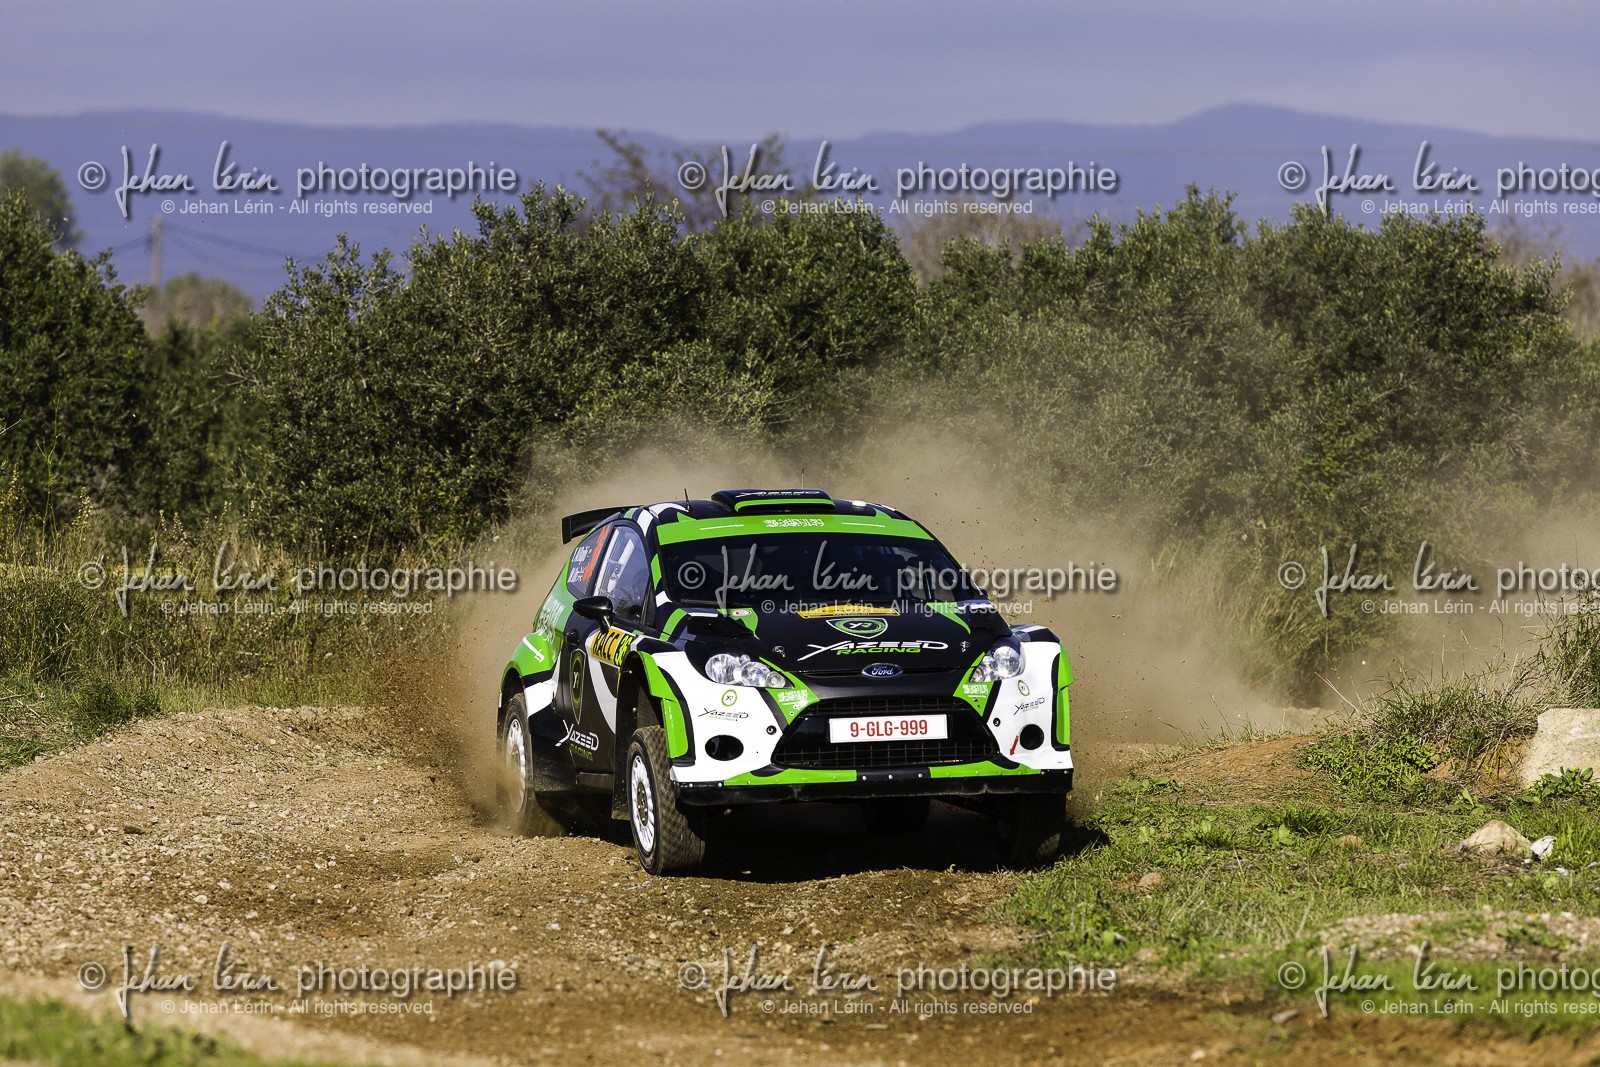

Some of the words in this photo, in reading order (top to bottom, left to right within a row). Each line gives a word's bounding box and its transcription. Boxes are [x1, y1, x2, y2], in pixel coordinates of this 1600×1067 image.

[797, 640, 948, 662] YAZEED
[836, 647, 921, 656] RACING
[871, 666, 893, 676] Ford
[555, 719, 600, 751] YAZEED
[850, 719, 928, 738] 9-GLG-999
